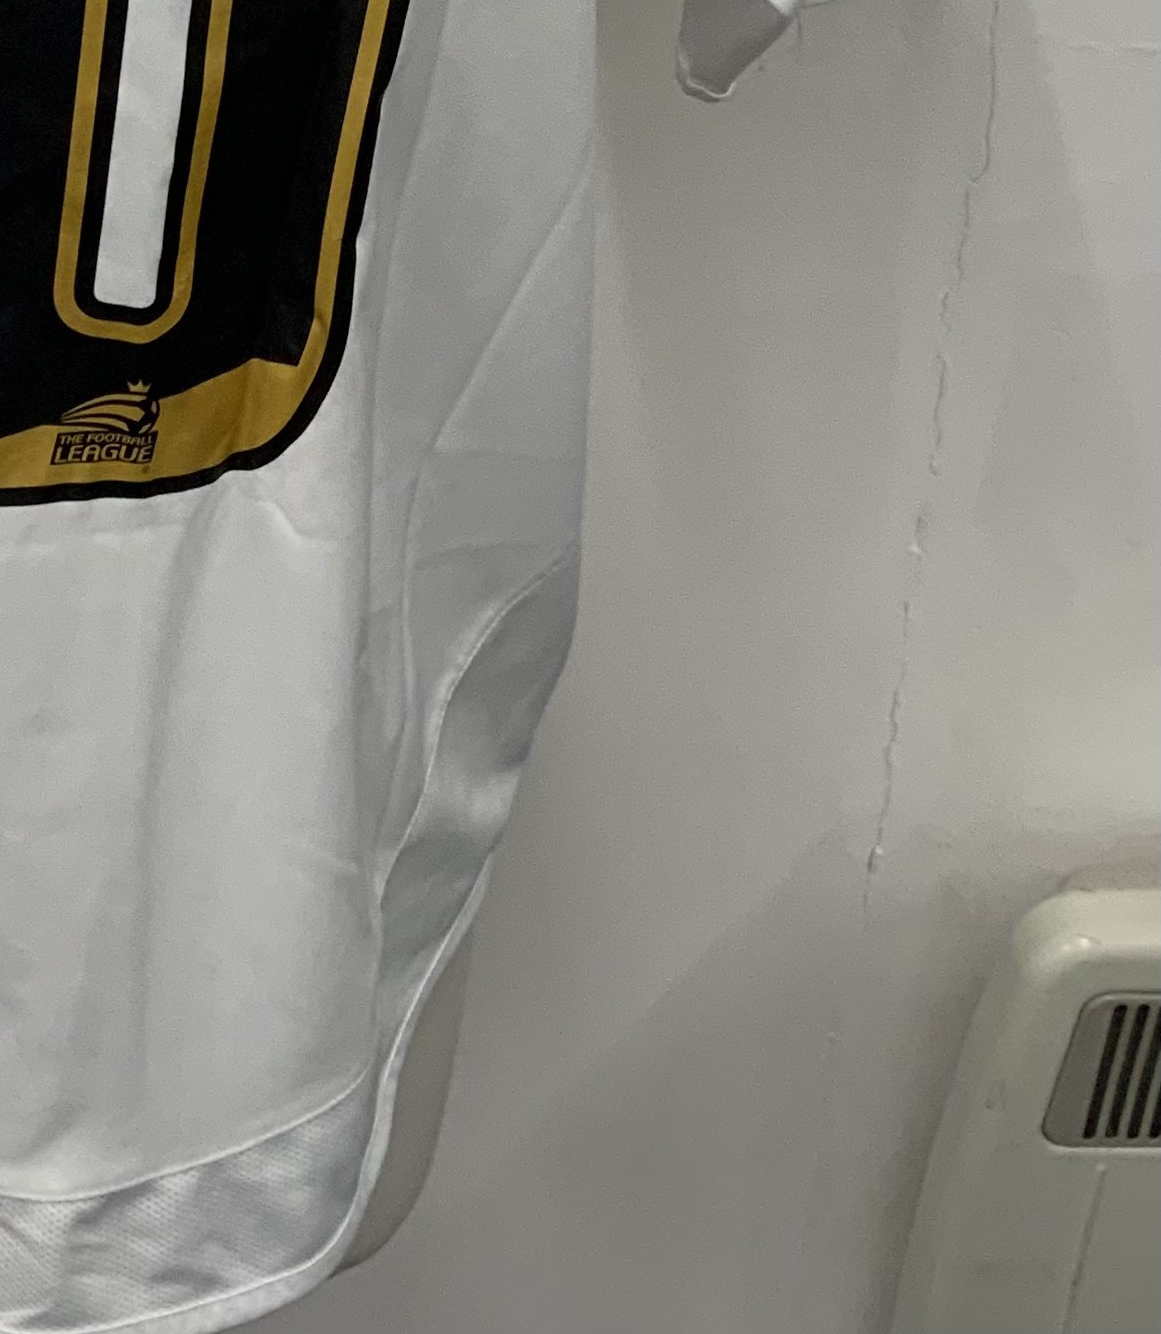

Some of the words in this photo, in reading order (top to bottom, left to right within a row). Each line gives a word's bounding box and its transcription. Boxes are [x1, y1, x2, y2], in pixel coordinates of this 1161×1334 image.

[60, 433, 84, 445] THE
[86, 432, 153, 445] FOOTBALL
[54, 443, 153, 464] LEAGUE
